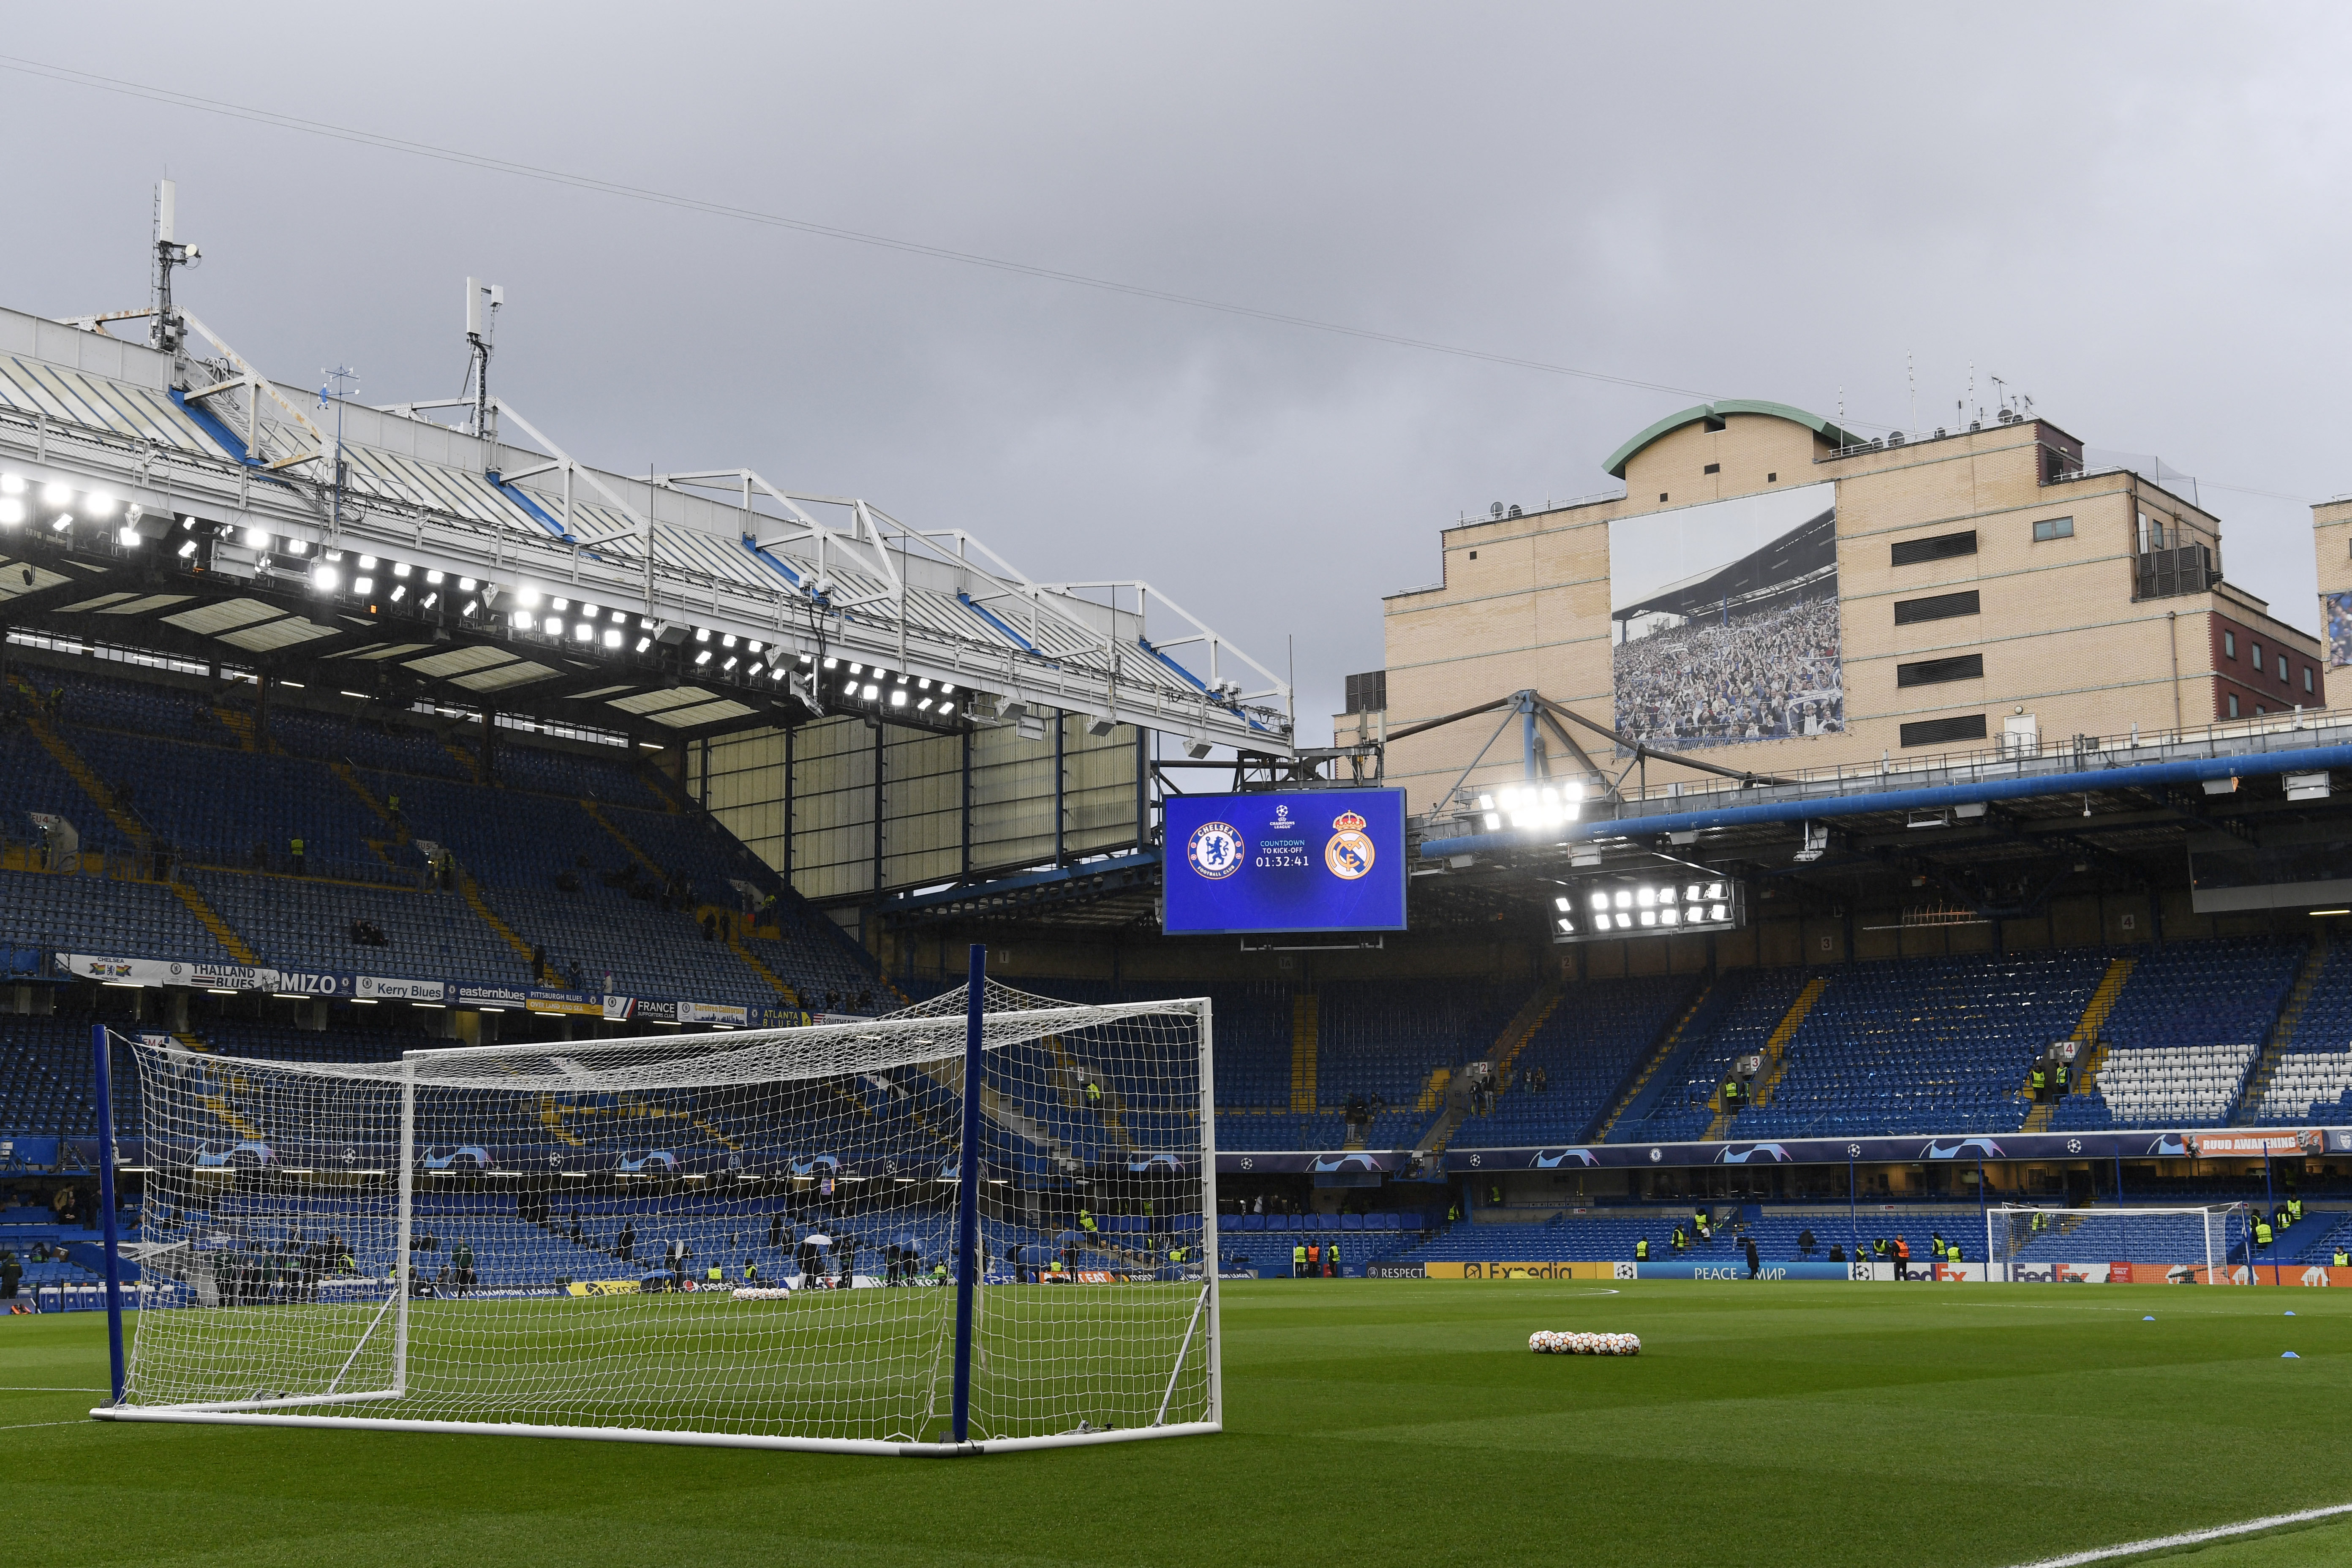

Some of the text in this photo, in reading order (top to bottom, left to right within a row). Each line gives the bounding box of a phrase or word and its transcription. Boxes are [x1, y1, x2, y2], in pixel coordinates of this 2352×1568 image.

[1198, 824, 1233, 836] CHELSEA
[1256, 856, 1309, 867] 01:32:41
[1197, 865, 1235, 877] FOOTBALL CLUB
[2124, 916, 2132, 927] 4
[1824, 938, 1830, 948] 3
[1564, 957, 1569, 966] 2
[191, 964, 255, 978] THAILAND
[216, 977, 254, 989] BLUES
[281, 972, 336, 994] MIZO
[378, 983, 408, 997] Kerry
[411, 985, 441, 998] Blues
[460, 986, 525, 1000] easternblues
[531, 991, 565, 1000] PITTSBURGH
[637, 1001, 675, 1013] FRANCE
[694, 1004, 744, 1014] Carefree California
[764, 1010, 798, 1020] ATLANTA
[762, 1018, 798, 1027] BLUES
[2066, 1044, 2073, 1054] 4
[1752, 1058, 1758, 1067] 3
[1481, 1063, 1486, 1073] 2
[2203, 1137, 2295, 1150] RUUD AWAKENING
[1088, 1272, 1107, 1282] EAT
[1381, 1268, 1424, 1278] RESPECT
[1695, 1268, 1738, 1280] PEACE
[1899, 1263, 1967, 1282] edEx
[476, 1289, 525, 1297] CHAMPIONS
[604, 1285, 639, 1295] Expe
